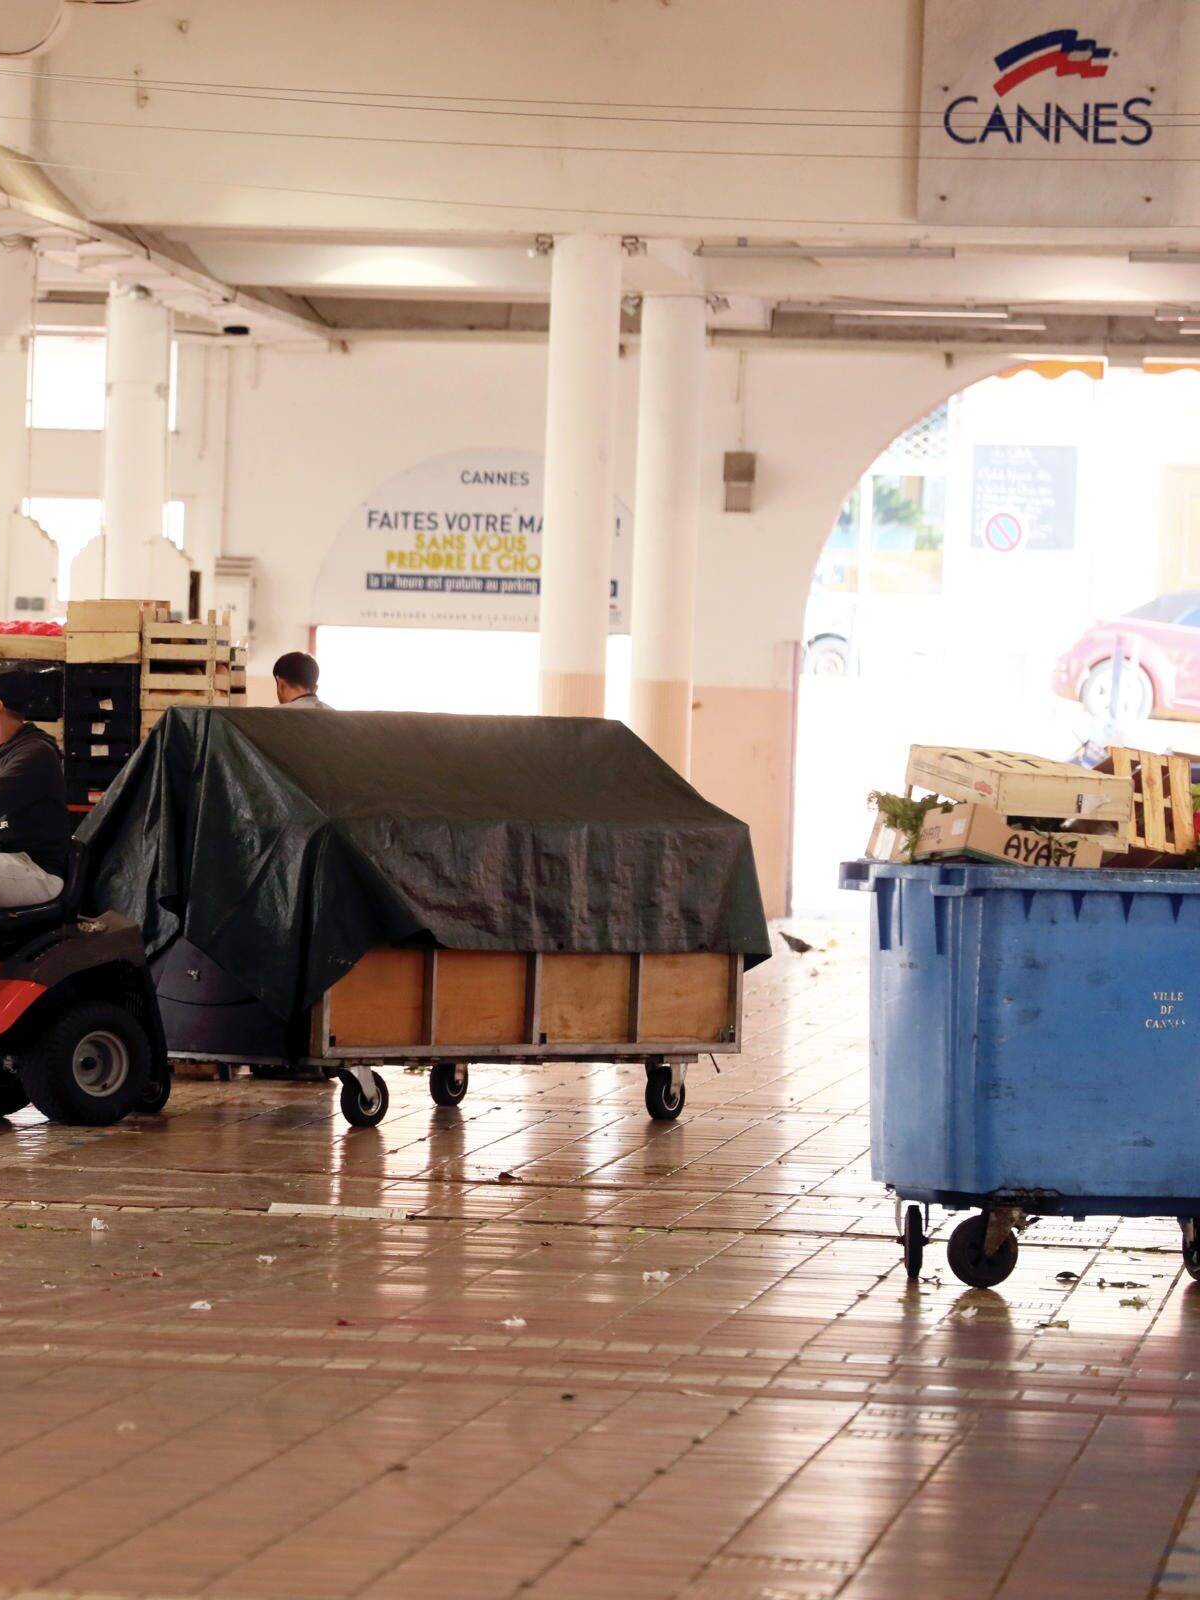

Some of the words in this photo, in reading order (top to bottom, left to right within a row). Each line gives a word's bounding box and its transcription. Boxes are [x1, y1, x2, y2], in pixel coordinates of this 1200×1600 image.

[943, 95, 1153, 146] CANNES
[460, 469, 530, 487] CANNES
[367, 510, 438, 531] FAITES
[445, 513, 511, 533] VOTRE
[415, 534, 465, 550] SANS
[473, 534, 527, 553] VOUS
[385, 551, 465, 570] PRENDRE
[471, 553, 490, 571] LE
[496, 554, 541, 573] CHO
[395, 575, 424, 588] heure
[427, 577, 442, 590] est
[445, 577, 482, 594] gratuite
[486, 580, 498, 591] au
[500, 579, 538, 595] parking
